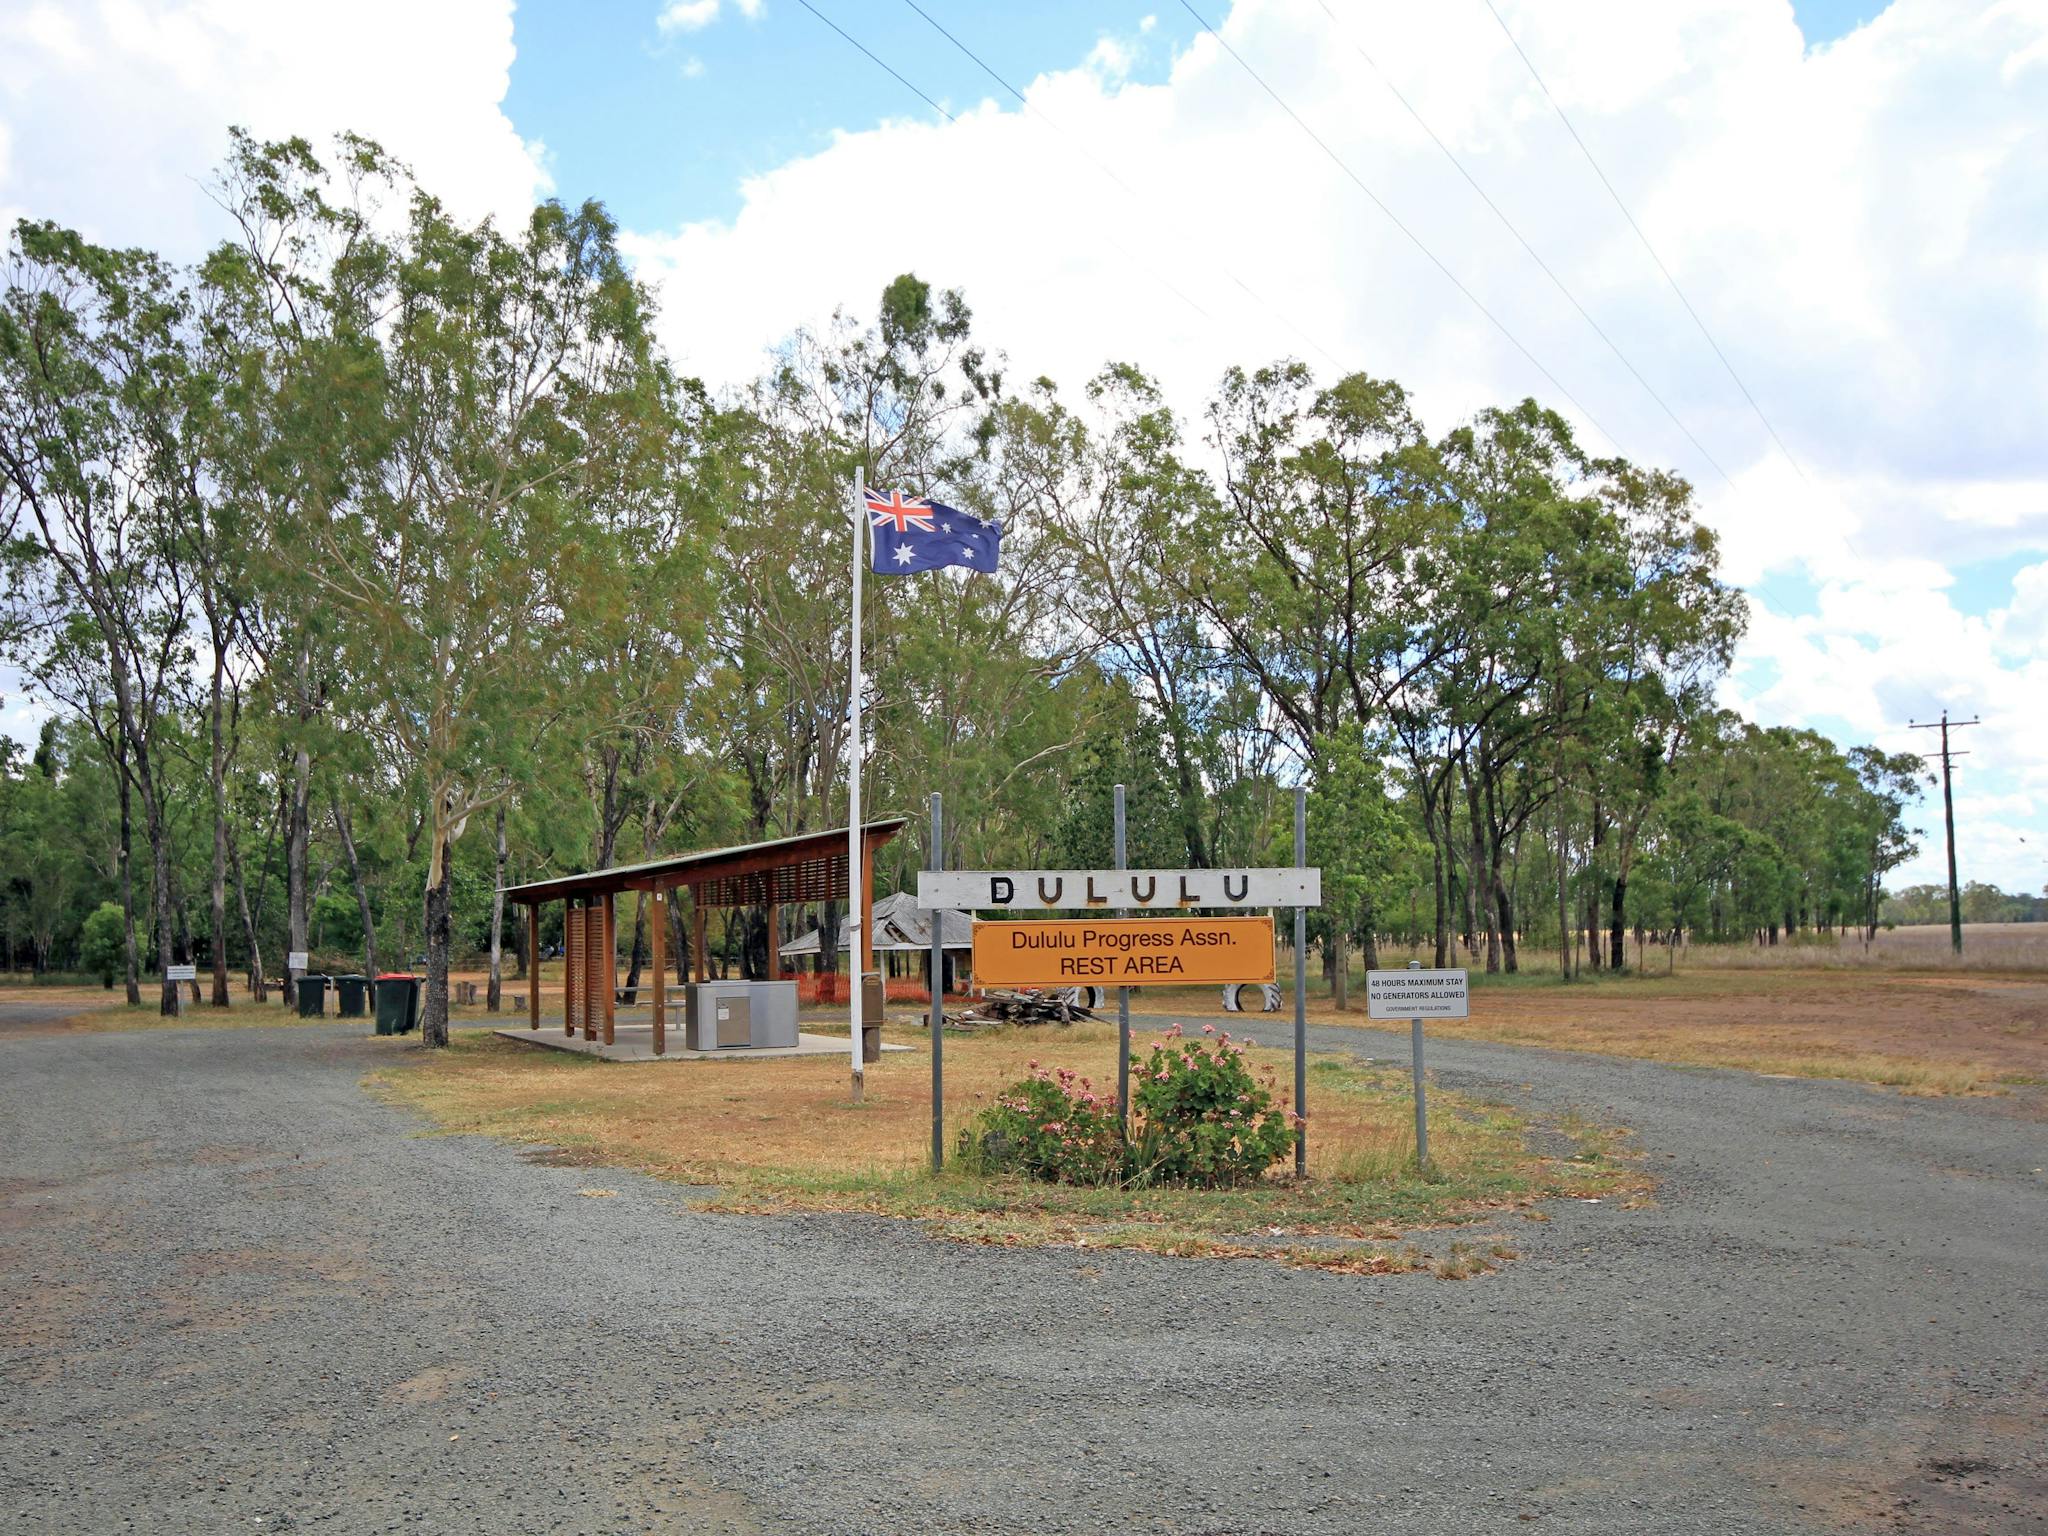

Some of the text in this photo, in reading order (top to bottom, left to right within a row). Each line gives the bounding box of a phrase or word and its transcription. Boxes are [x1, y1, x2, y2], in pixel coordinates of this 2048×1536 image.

[990, 874, 1249, 904] DULULU
[1012, 928, 1237, 951] Dululu Progress Assn.
[1061, 956, 1184, 975] REST AREA
[1381, 979, 1406, 987] HOURS
[1407, 979, 1444, 987] MAXIMUM
[1446, 978, 1463, 986] STAY
[1371, 991, 1465, 1000] NO GENERATORS ALLOWED
